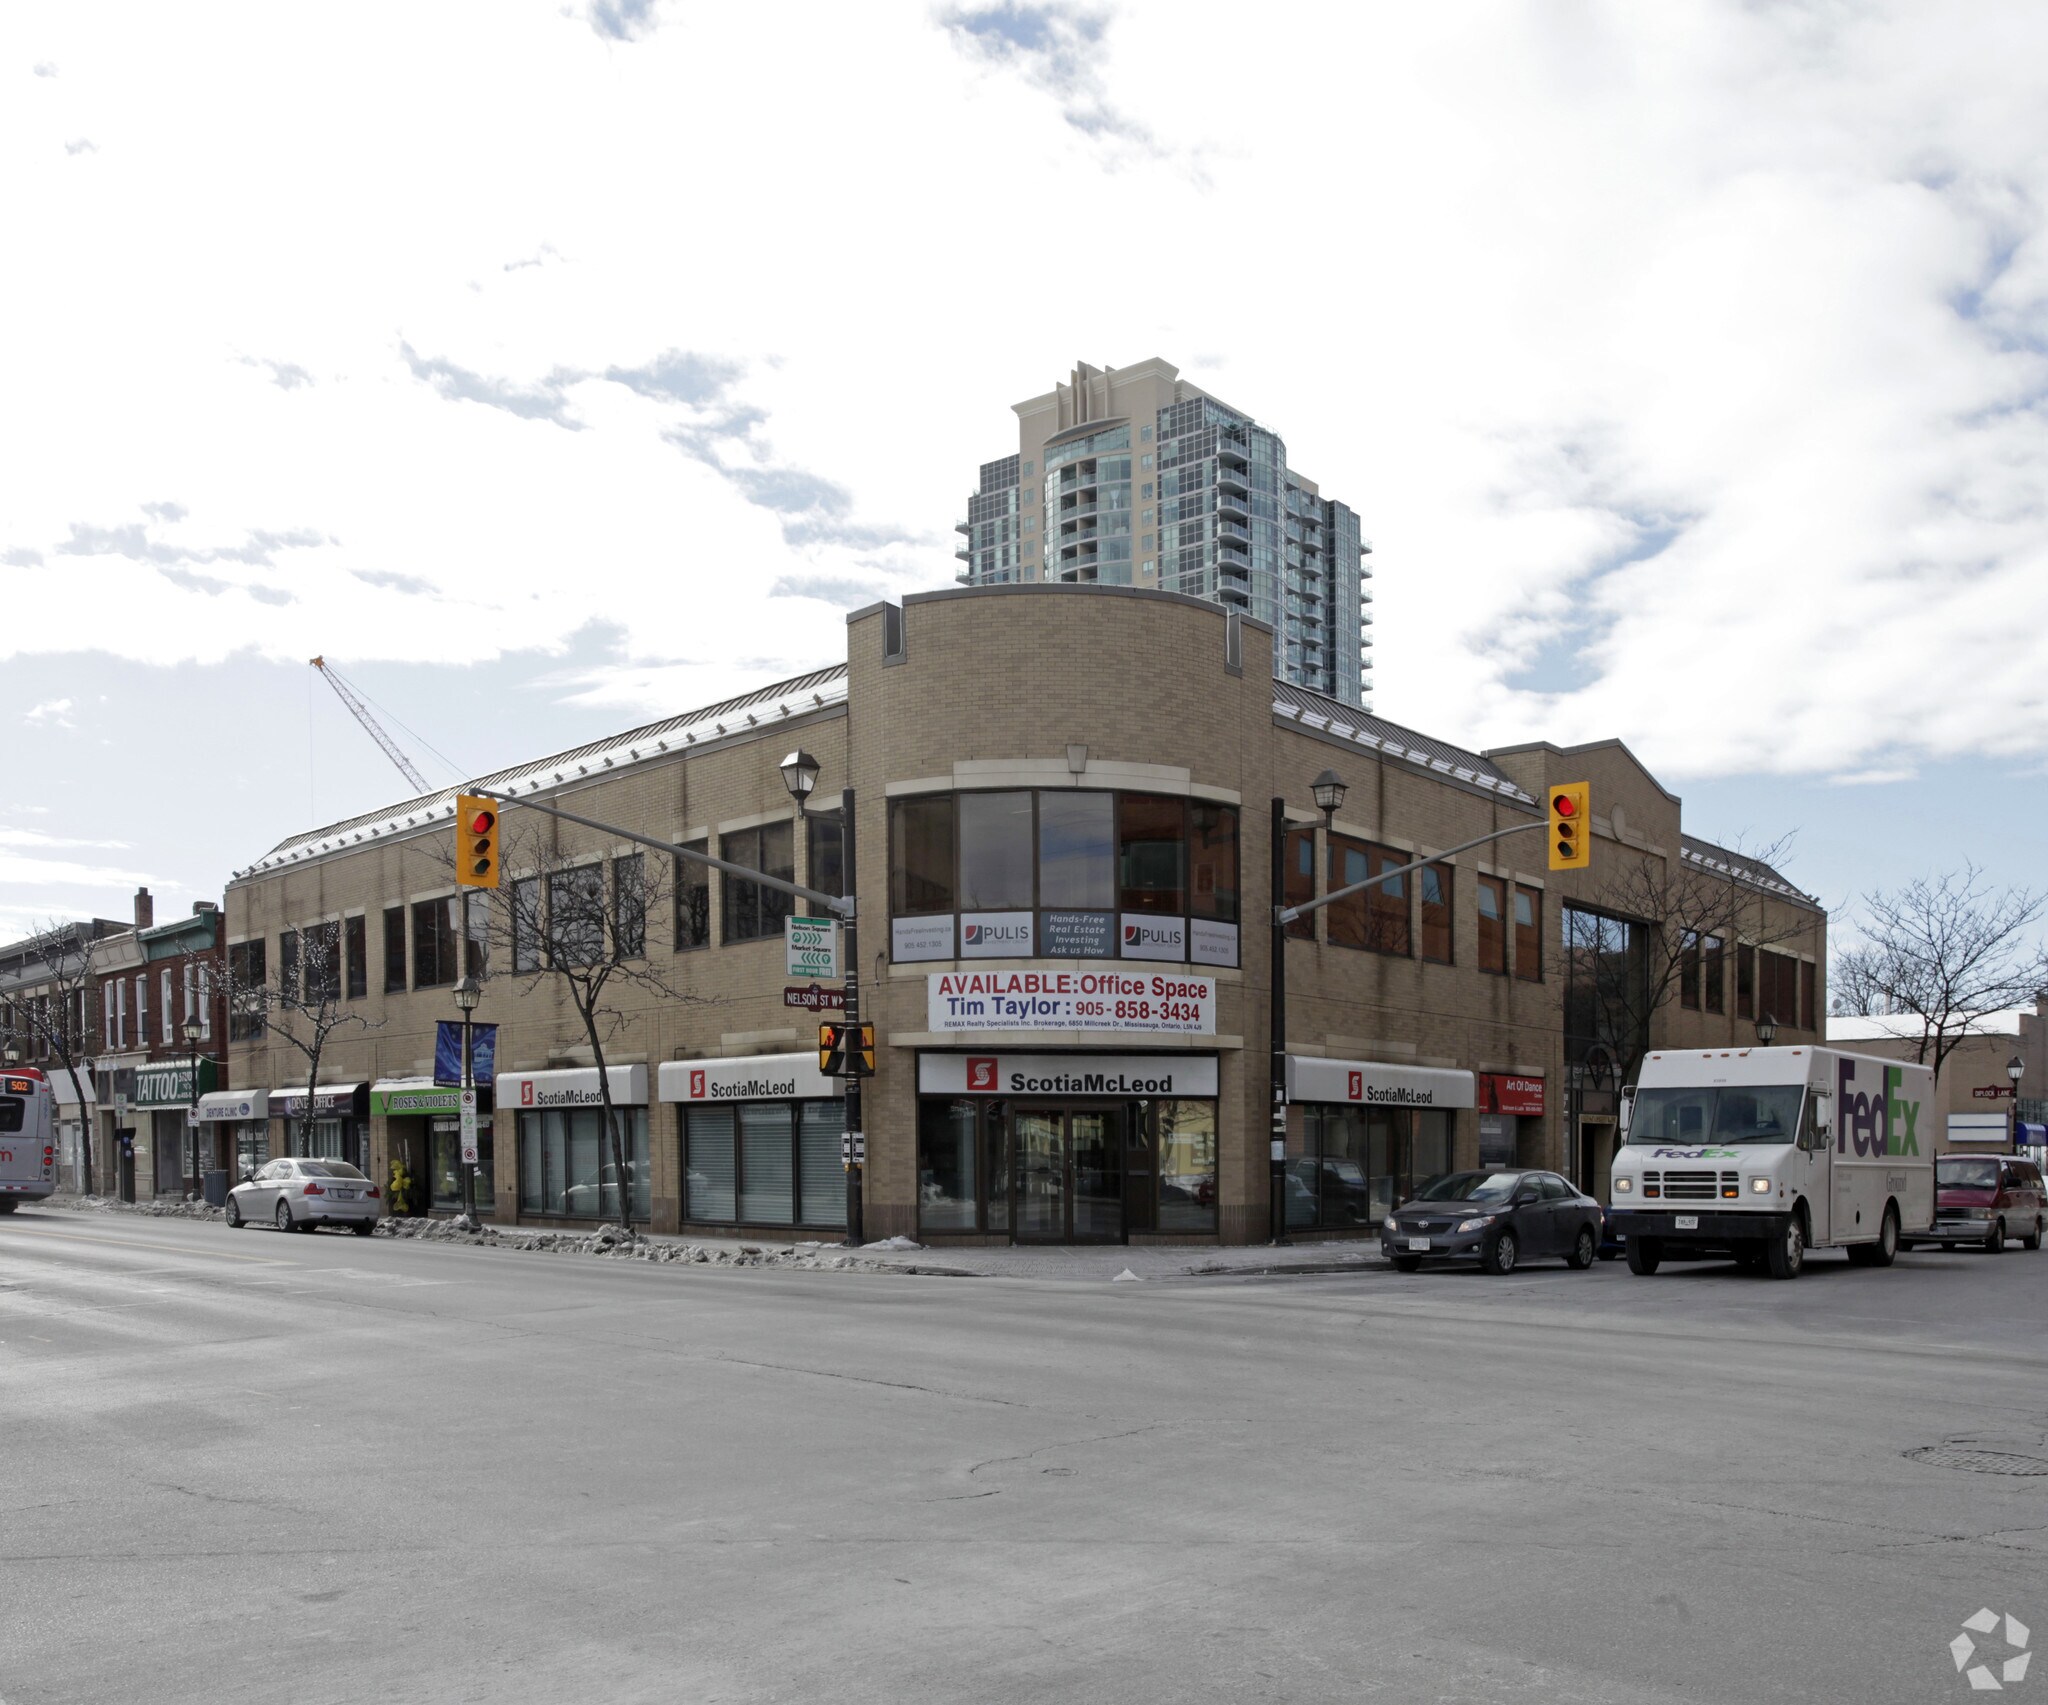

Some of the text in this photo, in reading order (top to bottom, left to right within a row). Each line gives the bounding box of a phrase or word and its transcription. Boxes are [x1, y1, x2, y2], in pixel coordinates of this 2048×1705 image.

[1050, 914, 1105, 924] Hands-Free
[984, 926, 1029, 940] PULIS
[1050, 925, 1106, 934] Real Estate
[1142, 929, 1181, 944] PULIS
[1055, 935, 1100, 946] Investing
[1050, 945, 1067, 954] Ask
[1084, 946, 1105, 955] How
[819, 968, 832, 976] FREE
[1151, 976, 1208, 1002] Space
[787, 992, 838, 1007] NELSON ST W
[947, 997, 985, 1016] Tim
[966, 1020, 985, 1028] Realty
[986, 1020, 1020, 1028] Specialists
[1033, 1020, 1067, 1028] Brokerage,
[1124, 1021, 1160, 1030] Mississauga,
[11, 1080, 28, 1091] 502
[136, 1072, 178, 1101] TATTOO
[711, 1078, 795, 1097] ScotiaMcLeod
[1011, 1073, 1172, 1092] ScotiaMcLeod
[1506, 1080, 1542, 1092] Art Of Dance
[1367, 1086, 1432, 1104] ScotiaMcLeod
[1975, 1089, 1995, 1097] DIPLOCK
[313, 1095, 335, 1109] OFFICE
[393, 1094, 458, 1109] ROSES & VIOLETS
[1838, 1058, 1920, 1158] FedEx
[449, 1121, 460, 1131] SHOP
[1650, 1148, 1742, 1159] FedEx
[1886, 1171, 1907, 1192] Ground
